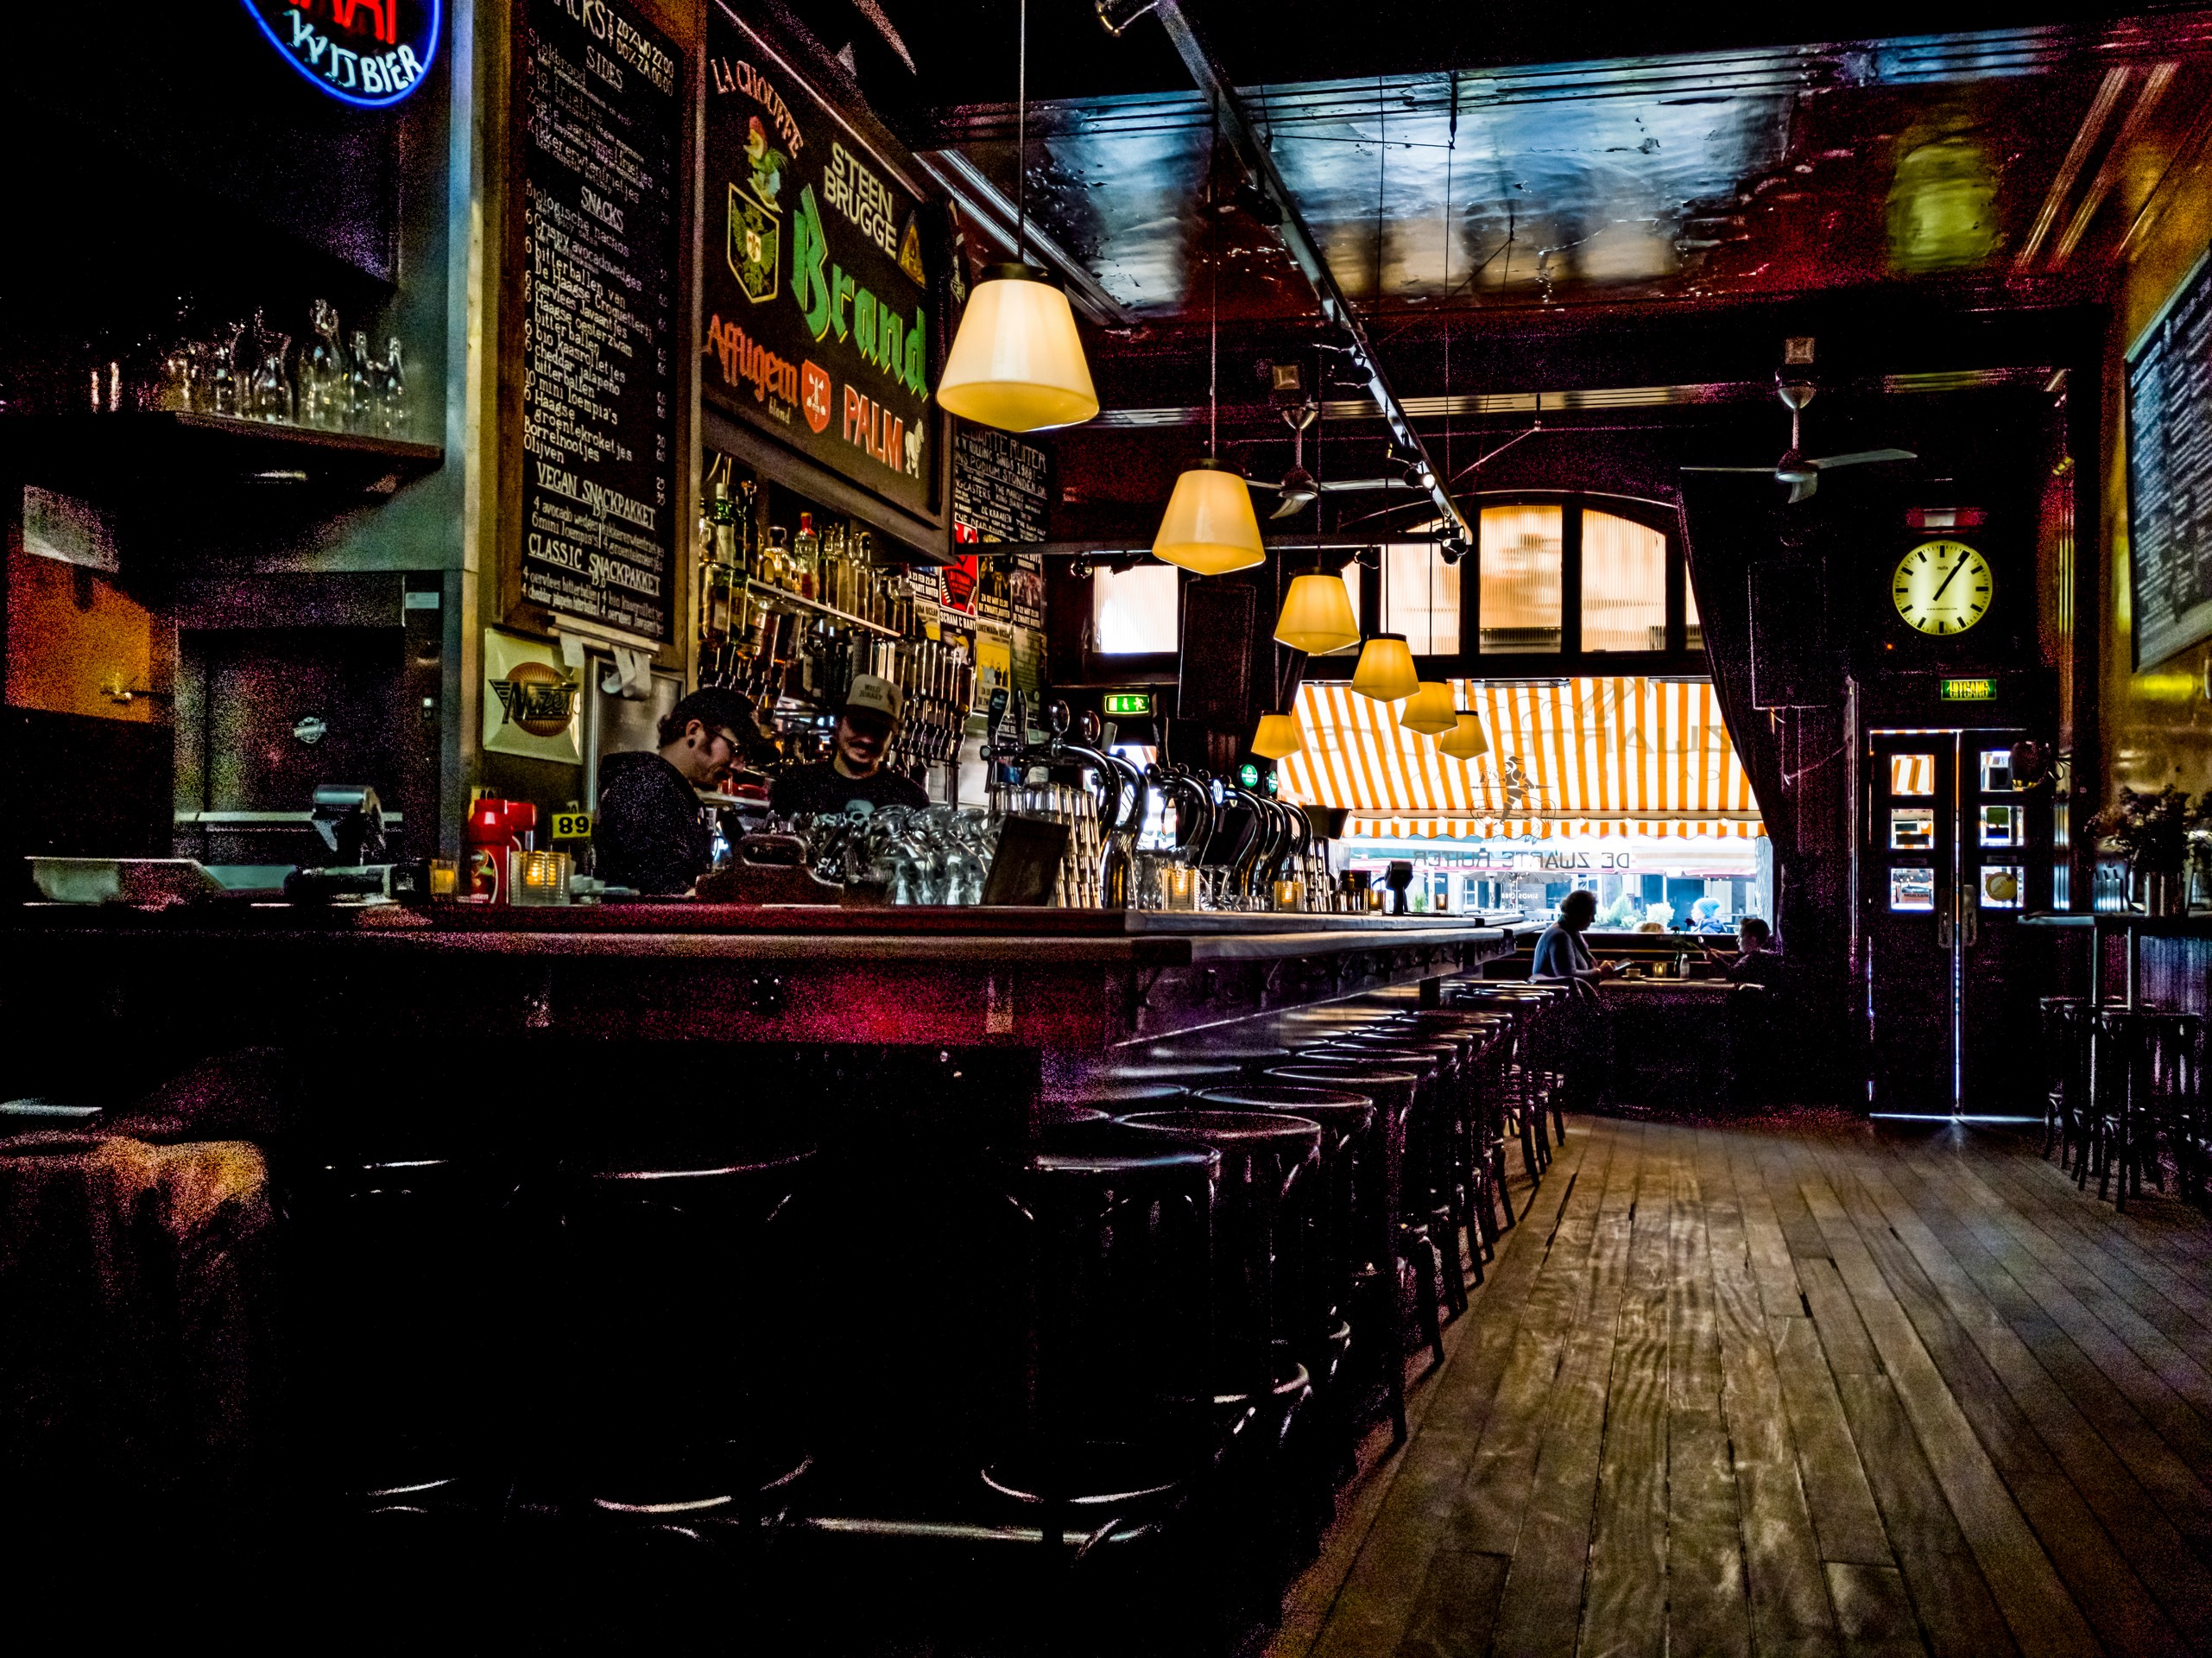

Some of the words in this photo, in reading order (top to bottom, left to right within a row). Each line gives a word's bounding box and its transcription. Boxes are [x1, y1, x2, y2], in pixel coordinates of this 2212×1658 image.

[586, 46, 623, 92] SIDES
[710, 56, 736, 94] LA
[736, 60, 804, 160] CHOUFFE
[831, 142, 894, 223] STEEN
[525, 209, 533, 225] 6
[534, 213, 570, 251] Crispy
[581, 186, 623, 233] SNACKS
[824, 165, 897, 256] BRUGGE
[525, 236, 532, 253] 6
[535, 241, 604, 297] bitterballen
[608, 289, 625, 309] van
[525, 270, 532, 288] 6
[535, 257, 548, 279] De
[553, 269, 590, 303] Haagse
[791, 183, 928, 403] Brand
[524, 286, 531, 302] 6
[534, 291, 572, 328] Haagse
[524, 319, 532, 336] 6
[536, 323, 553, 346] bio
[557, 332, 625, 383] kaasrolletjes
[524, 334, 532, 351] 6
[534, 342, 574, 371] cheddar
[534, 306, 599, 357] bitterballen
[524, 368, 535, 386] 10
[539, 378, 563, 399] mini
[568, 387, 617, 425] loempia's
[534, 354, 595, 398] bitterballen
[524, 383, 531, 401] 6
[534, 389, 575, 425] Haagse
[523, 432, 564, 464] Olijven
[534, 408, 632, 461] groentekroketjes
[844, 384, 903, 472] PALM
[534, 496, 540, 509] 4
[537, 462, 578, 498] VEGAN
[582, 480, 655, 530] SNACKPAKKET
[528, 533, 583, 572] CLASSIC
[589, 554, 660, 596] SNACKPAKKET
[603, 536, 608, 549] 4
[522, 566, 529, 579] 4
[602, 591, 606, 603] 4
[940, 611, 958, 627] SCRAM
[959, 617, 963, 627] C
[964, 619, 976, 630] BABY
[558, 816, 590, 835] 89
